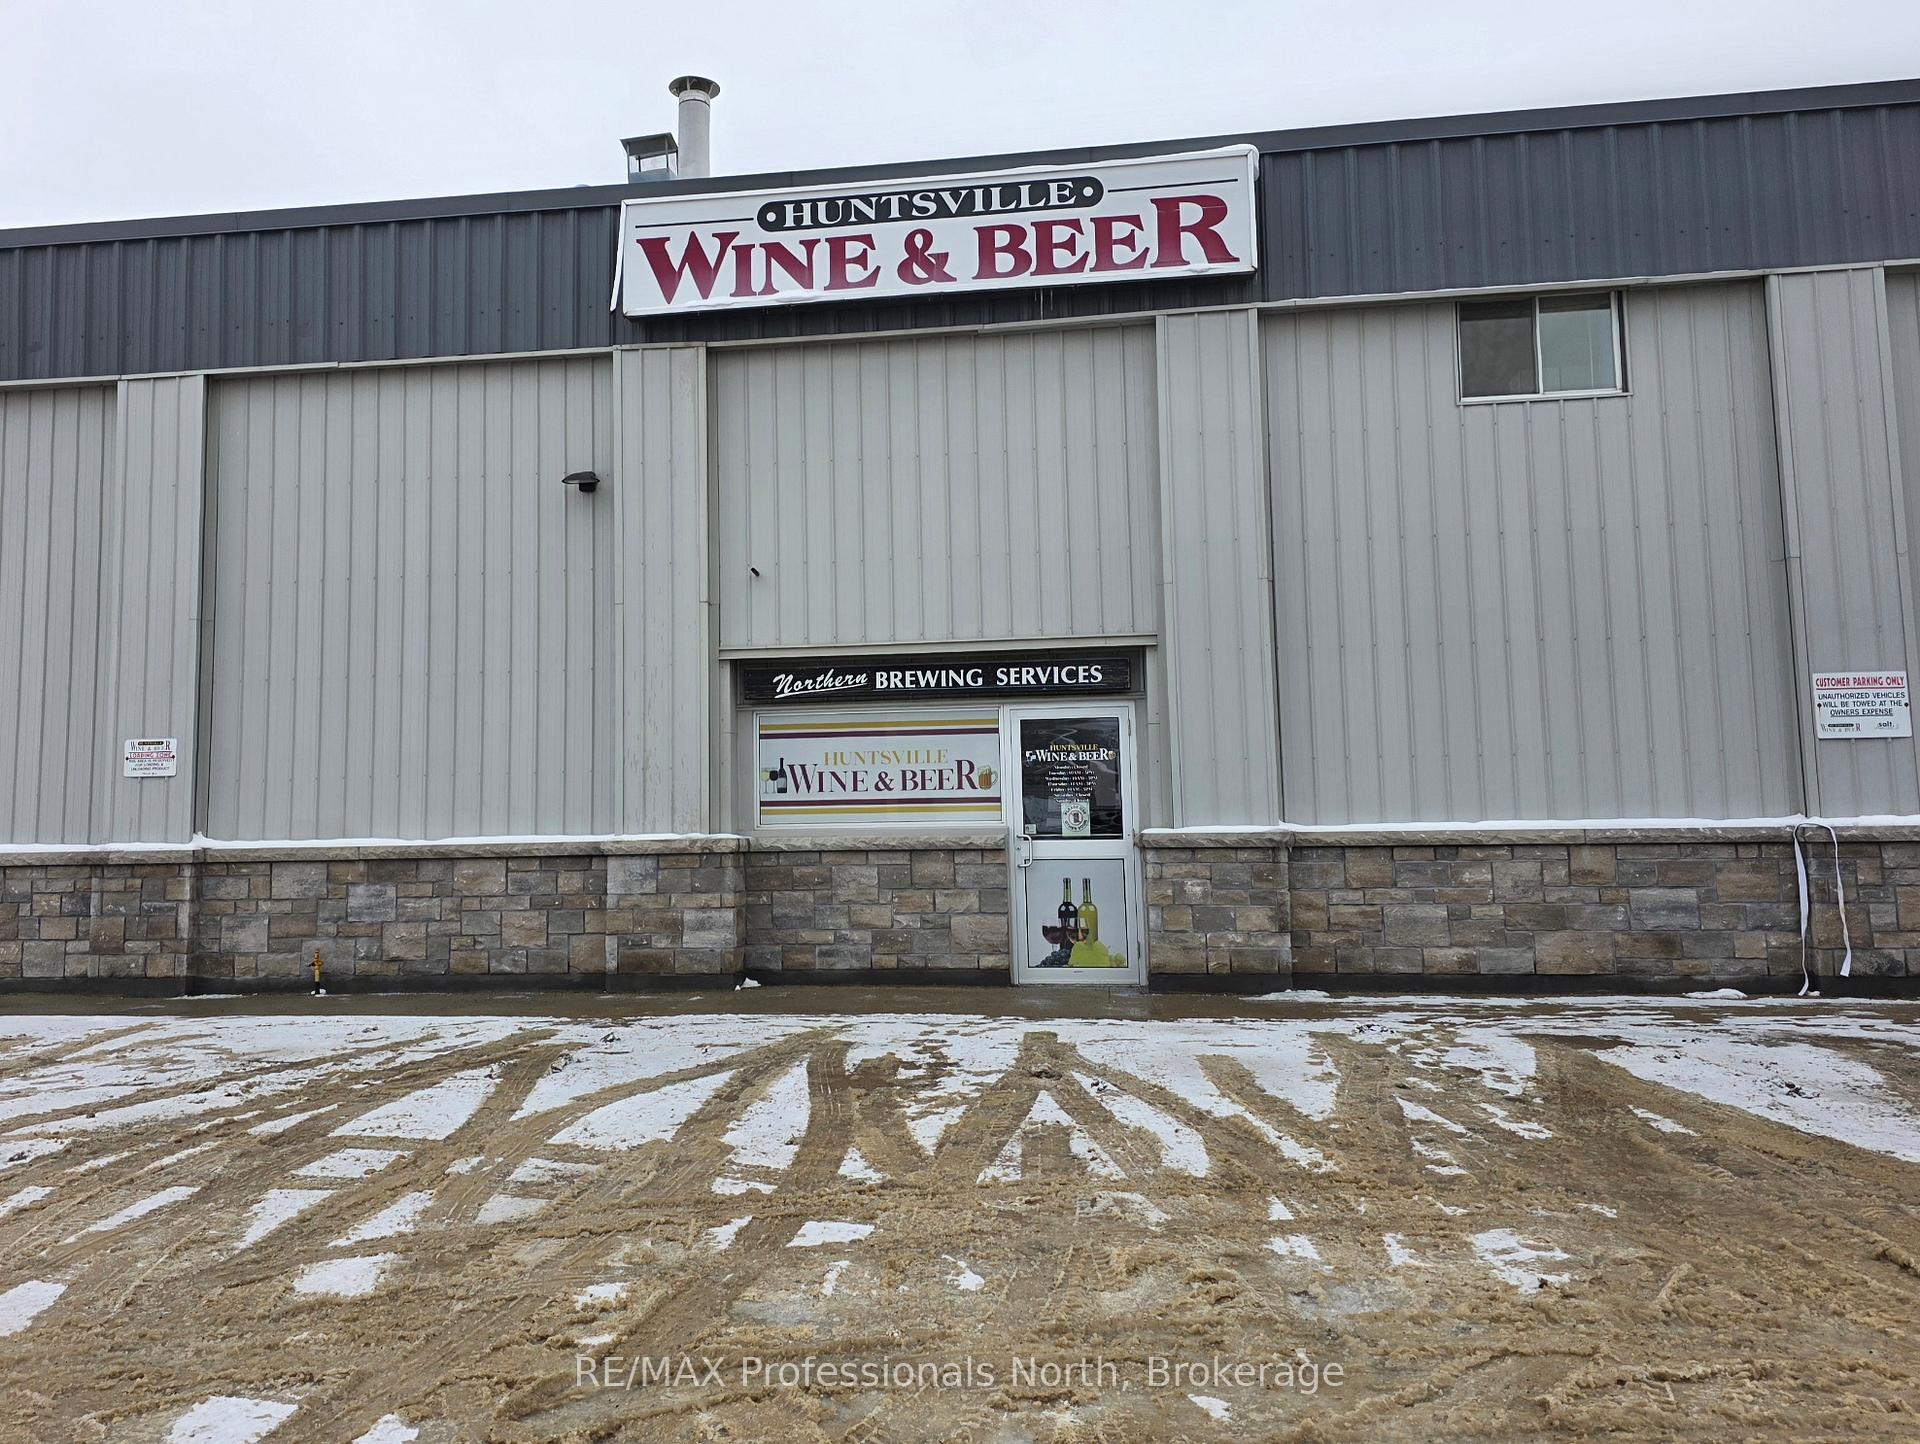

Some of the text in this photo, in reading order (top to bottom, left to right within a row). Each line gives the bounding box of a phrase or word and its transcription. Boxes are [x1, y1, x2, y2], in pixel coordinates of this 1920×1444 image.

[783, 180, 1077, 228] HUNTSVILLE
[636, 194, 1240, 304] WINE & BEER
[773, 665, 1103, 695] Northern BREWING SERVICES
[1816, 676, 1904, 687] CUSTOMER PARKING ONLY
[824, 749, 948, 766] HUNTSVILLE
[1035, 748, 1109, 762] WINE & BEER
[787, 759, 978, 794] WINE & BEER
